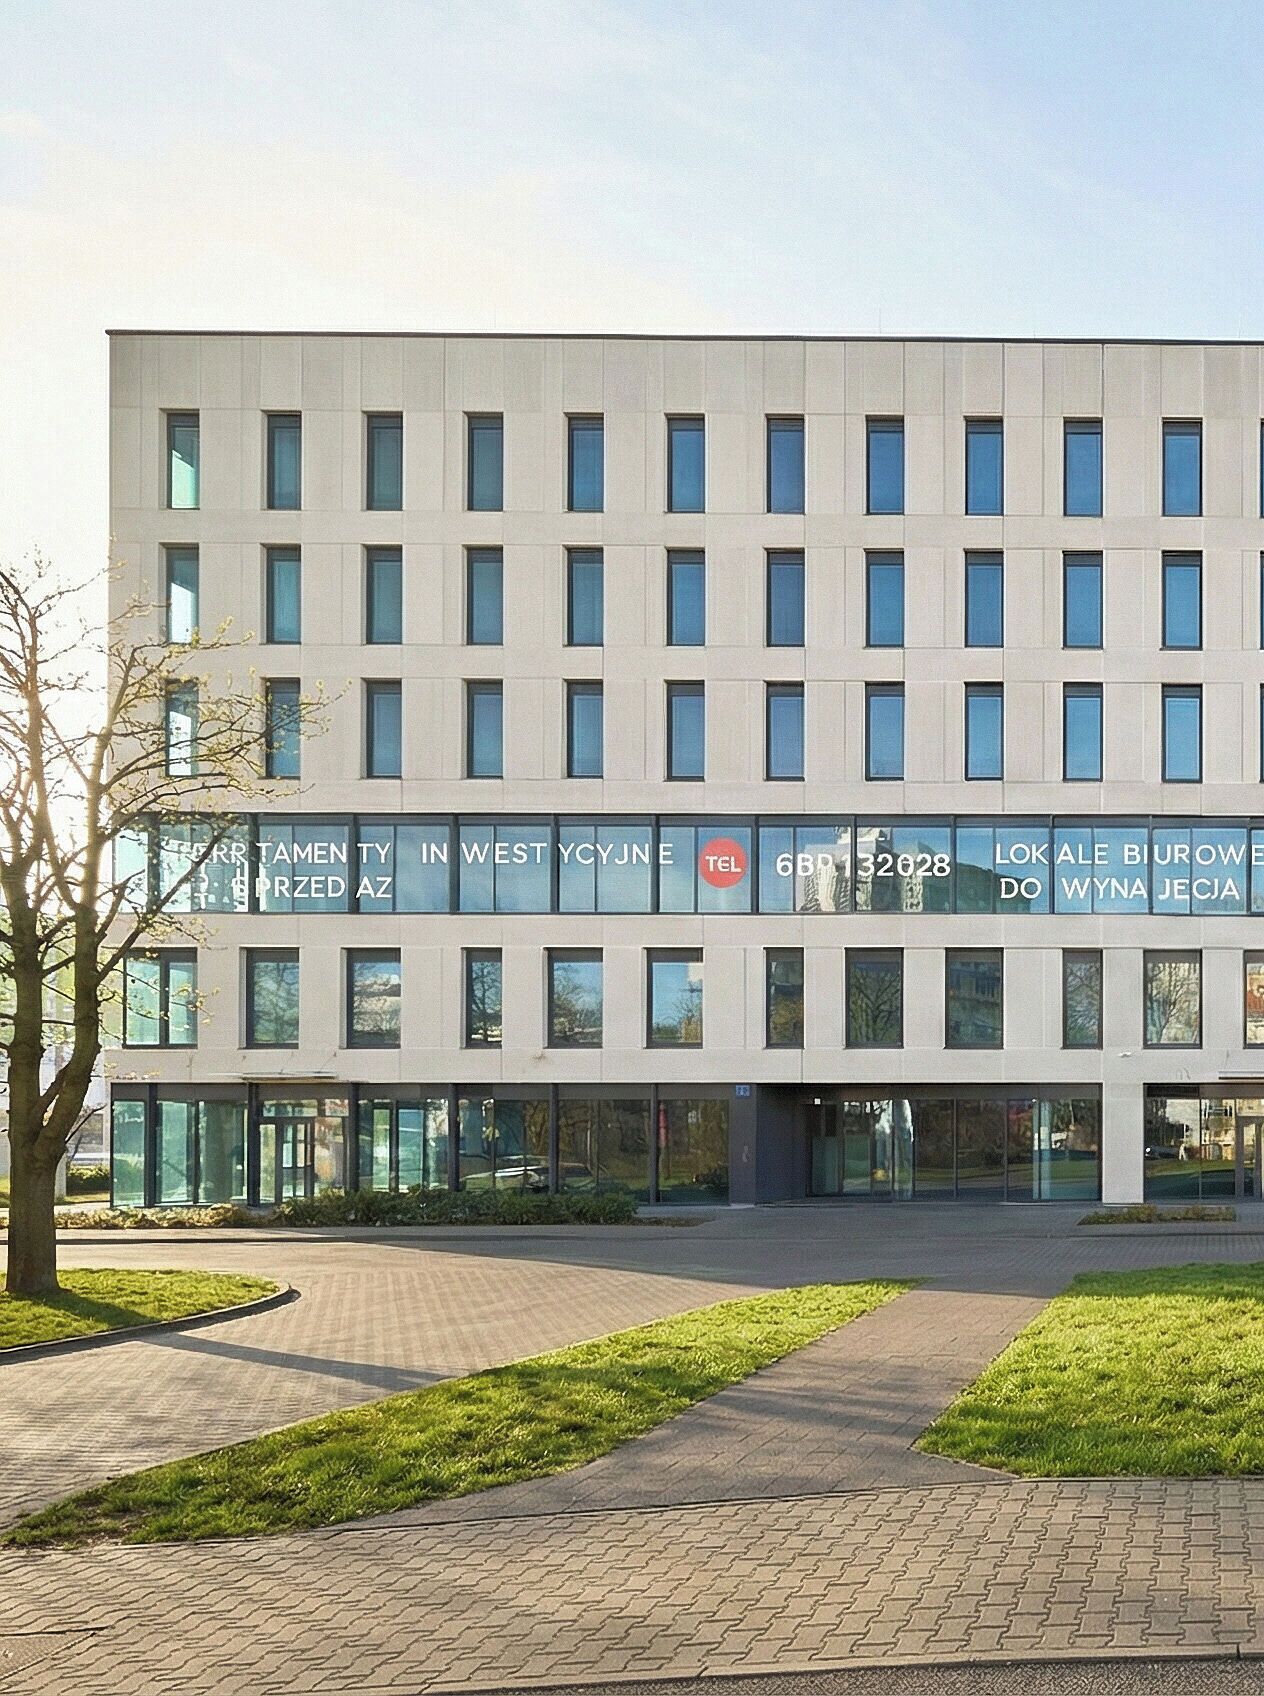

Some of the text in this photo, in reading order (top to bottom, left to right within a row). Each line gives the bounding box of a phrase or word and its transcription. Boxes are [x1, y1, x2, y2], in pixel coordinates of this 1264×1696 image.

[705, 855, 742, 873] TEL
[995, 843, 1109, 865] LOKALE
[1000, 878, 1042, 899] DO
